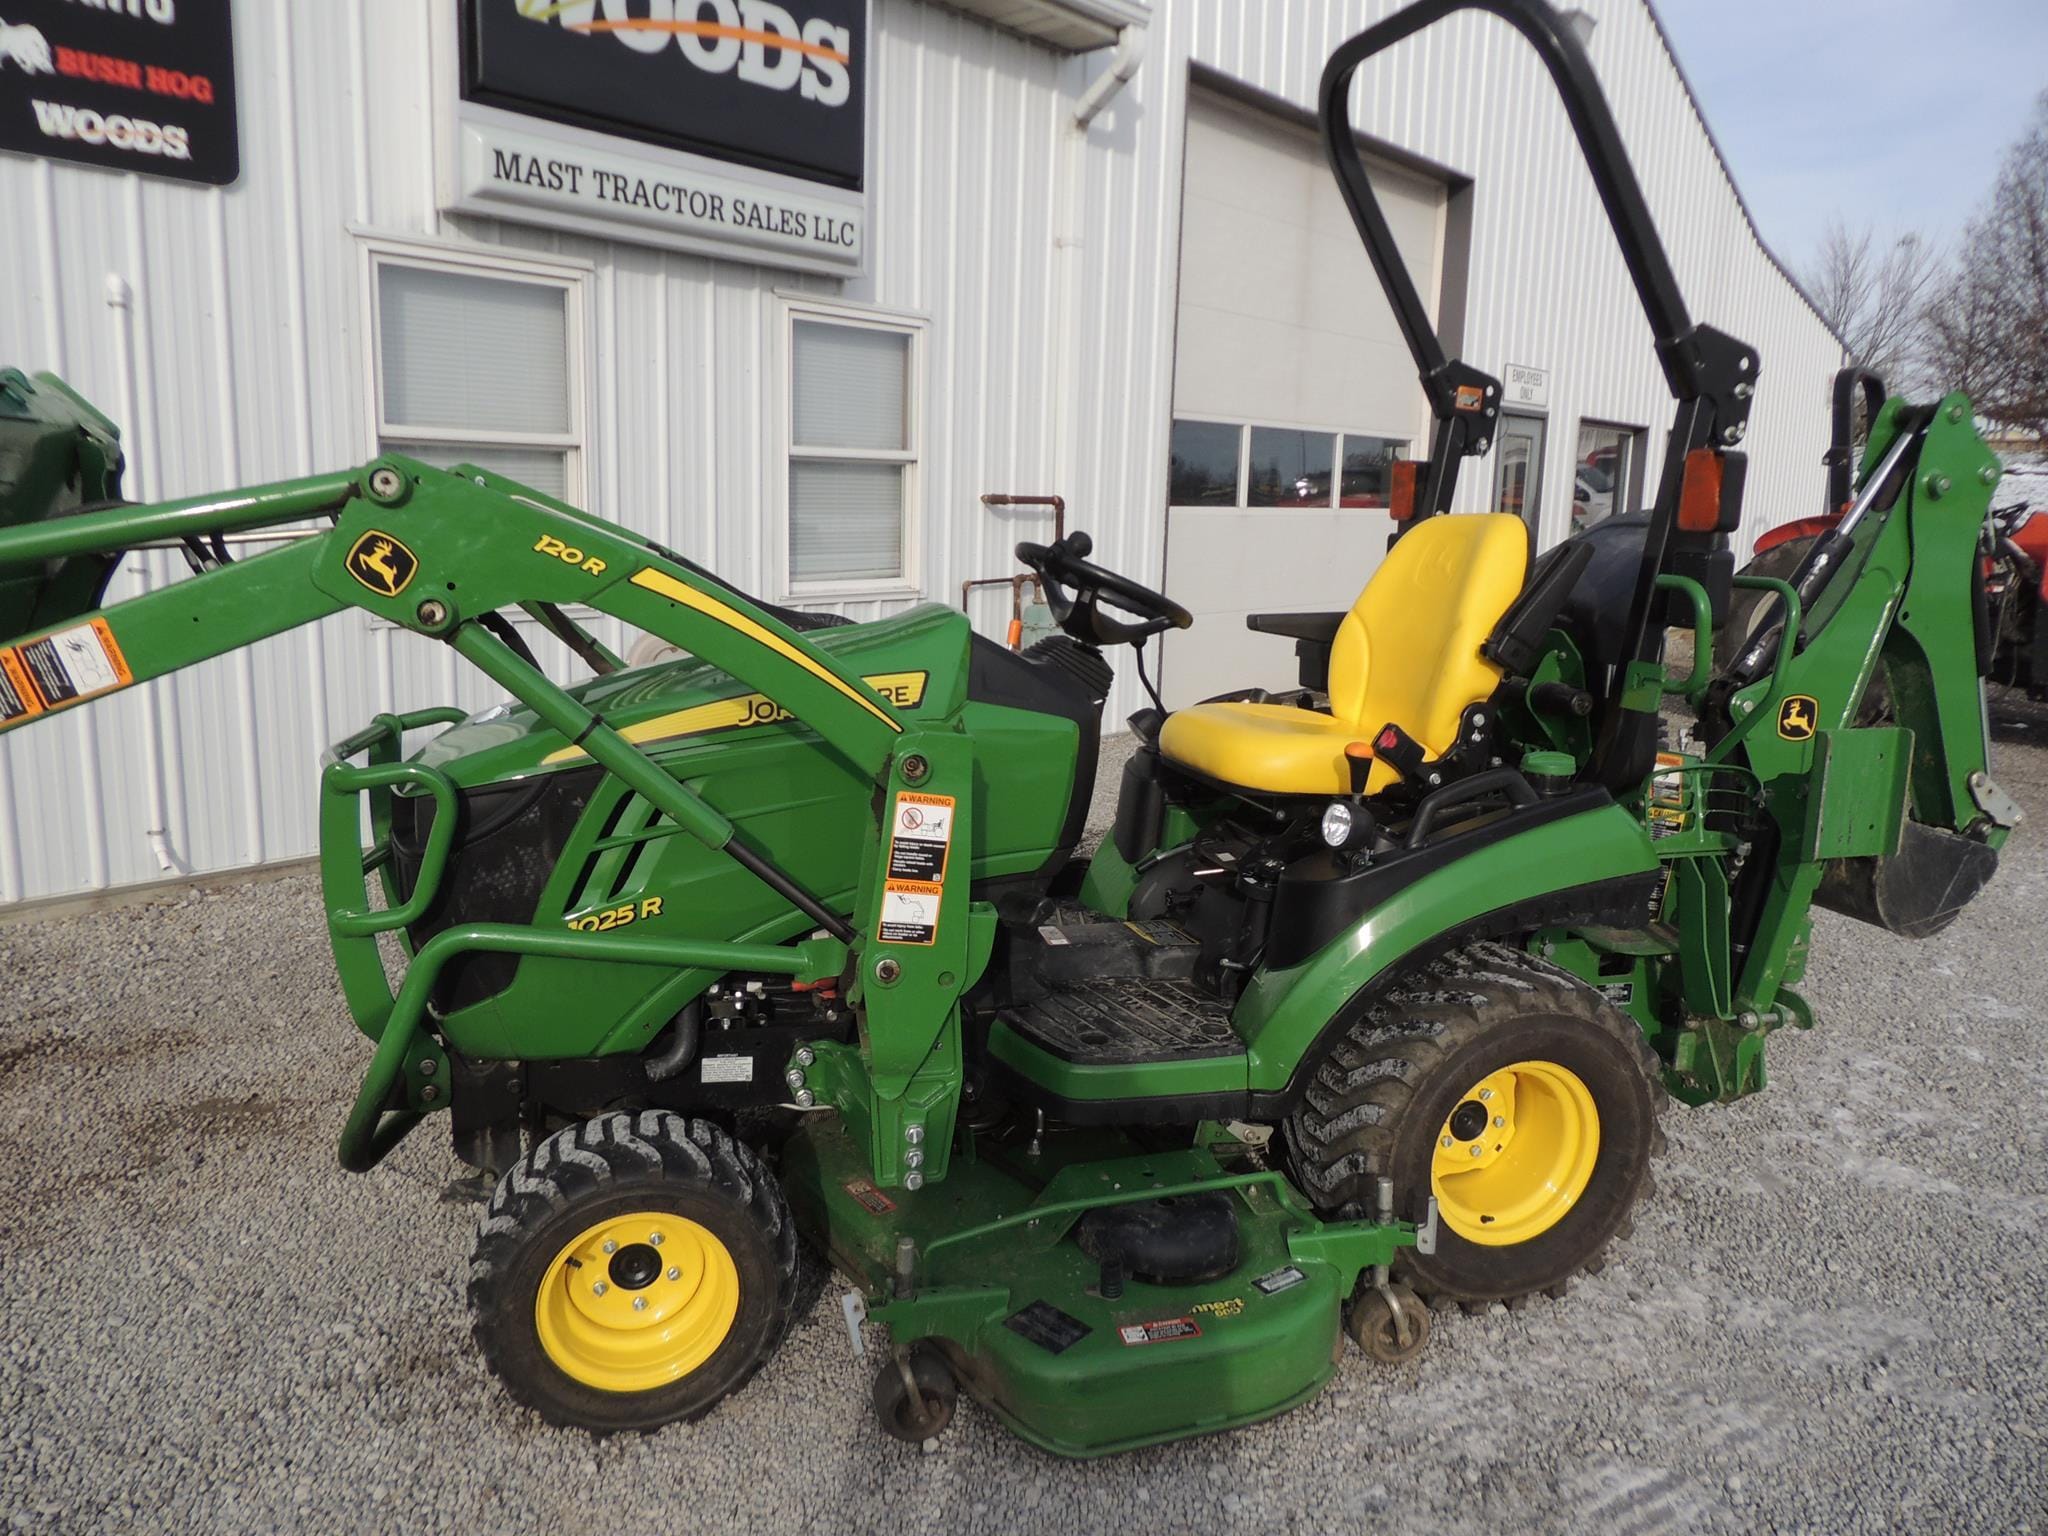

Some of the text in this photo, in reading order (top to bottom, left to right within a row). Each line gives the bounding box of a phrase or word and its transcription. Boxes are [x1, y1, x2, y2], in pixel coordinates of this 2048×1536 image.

[55, 45, 214, 105] BUSH HOG
[31, 99, 192, 160] WOODS
[493, 148, 855, 247] MAST TRACTOR SALES LLC
[1512, 369, 1542, 386] EMPLOYEES
[1520, 386, 1533, 400] ONLY
[908, 794, 951, 807] WARNING
[896, 885, 938, 894] WARNING
[641, 896, 664, 919] R
